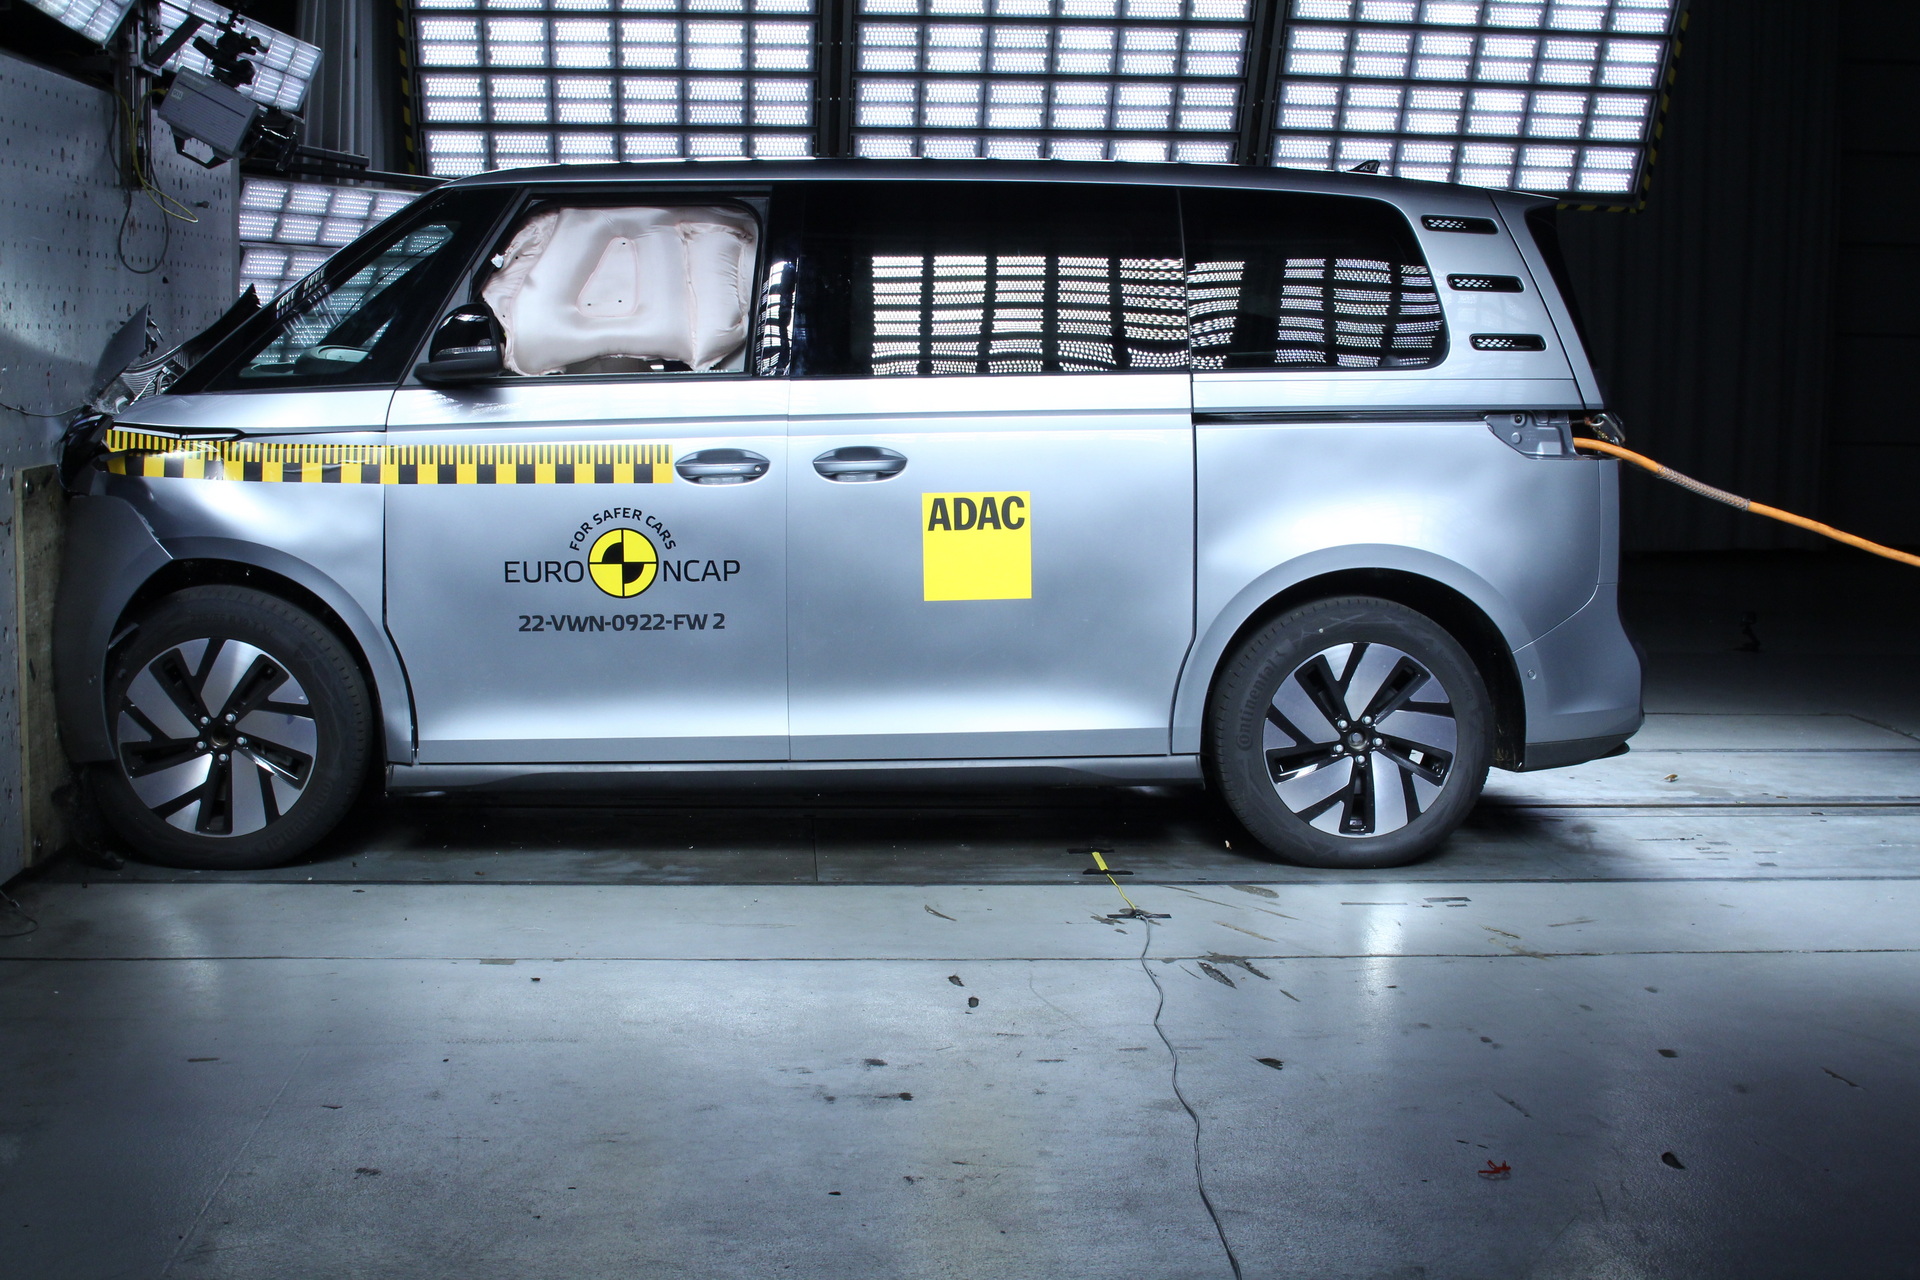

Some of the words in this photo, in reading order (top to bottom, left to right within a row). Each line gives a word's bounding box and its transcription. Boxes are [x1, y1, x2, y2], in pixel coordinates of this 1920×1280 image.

[569, 522, 593, 551] FOR
[593, 507, 643, 525] SAFER
[645, 515, 677, 550] CARS
[927, 495, 1026, 532] ADAC
[504, 560, 585, 583] EURO
[663, 559, 741, 582] NCAP
[518, 613, 708, 632] 22-VWN-0922-FW
[712, 612, 726, 630] 2
[1235, 658, 1279, 752] Continental
